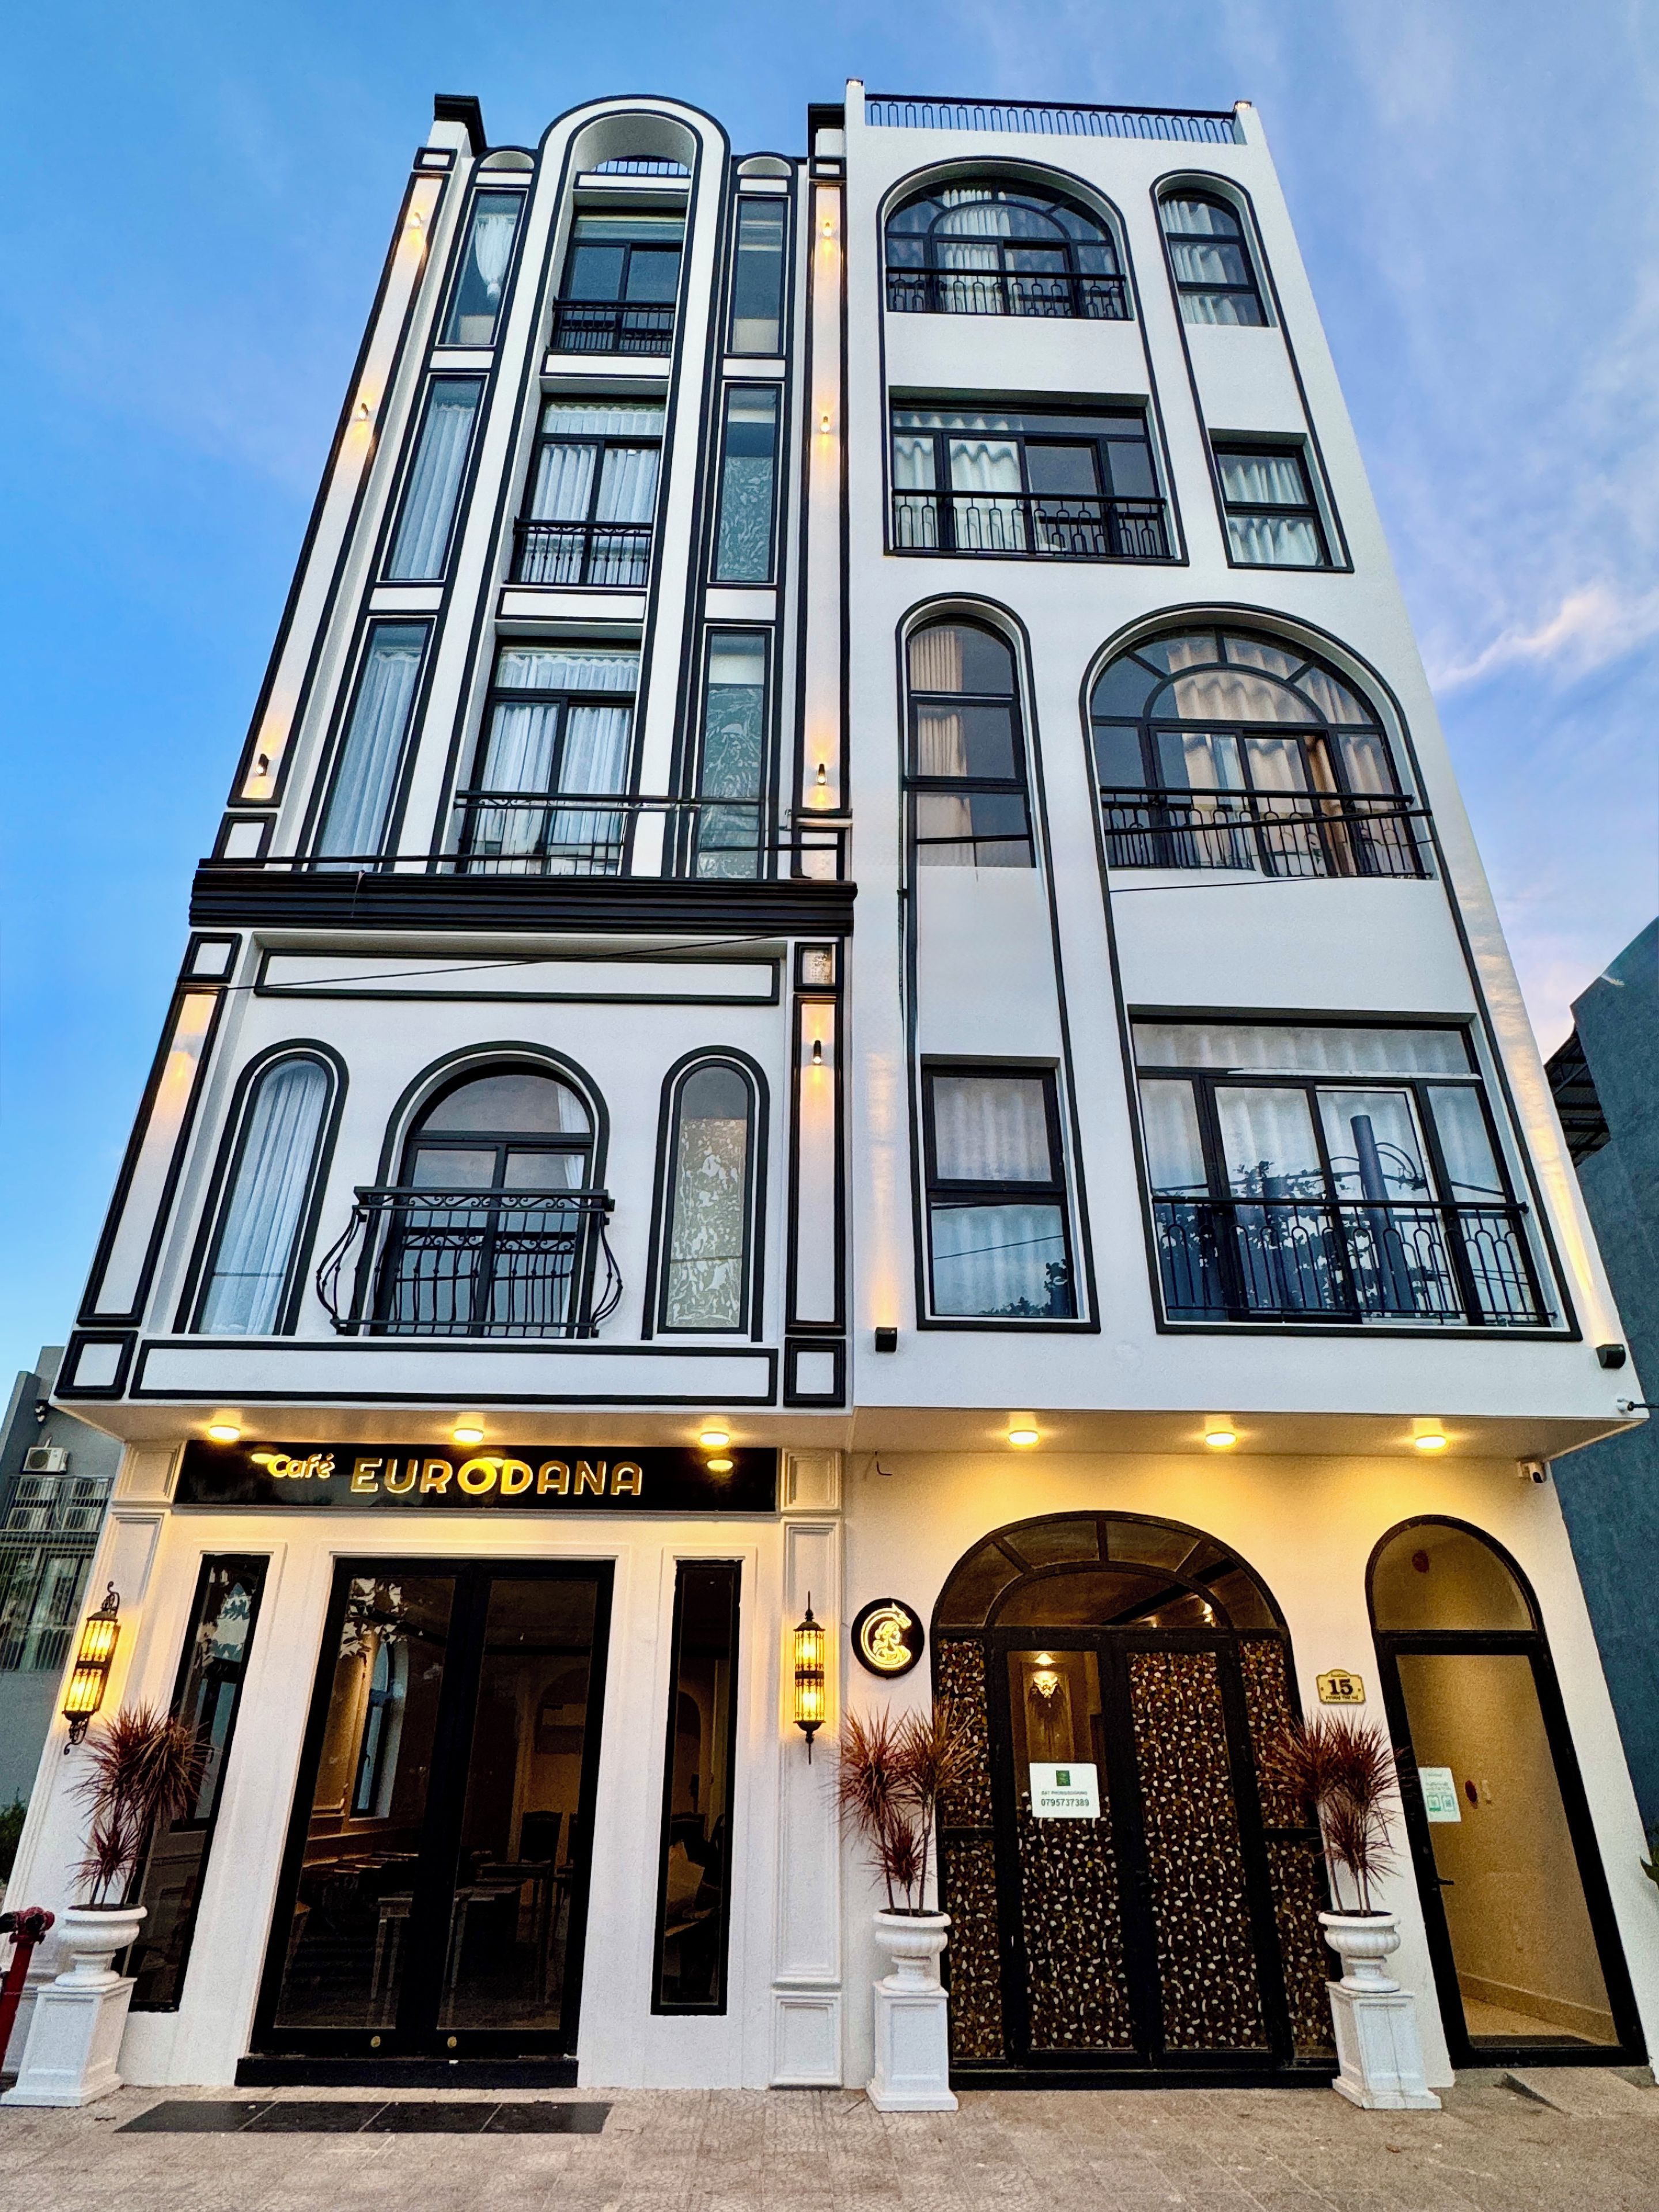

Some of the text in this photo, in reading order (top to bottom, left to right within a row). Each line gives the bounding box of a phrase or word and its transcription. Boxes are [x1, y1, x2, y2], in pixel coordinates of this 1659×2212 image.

[267, 1453, 643, 1495] Café EURODANA
[1327, 1679, 1353, 1695] 15
[1040, 1798, 1090, 1806] 0795737389
